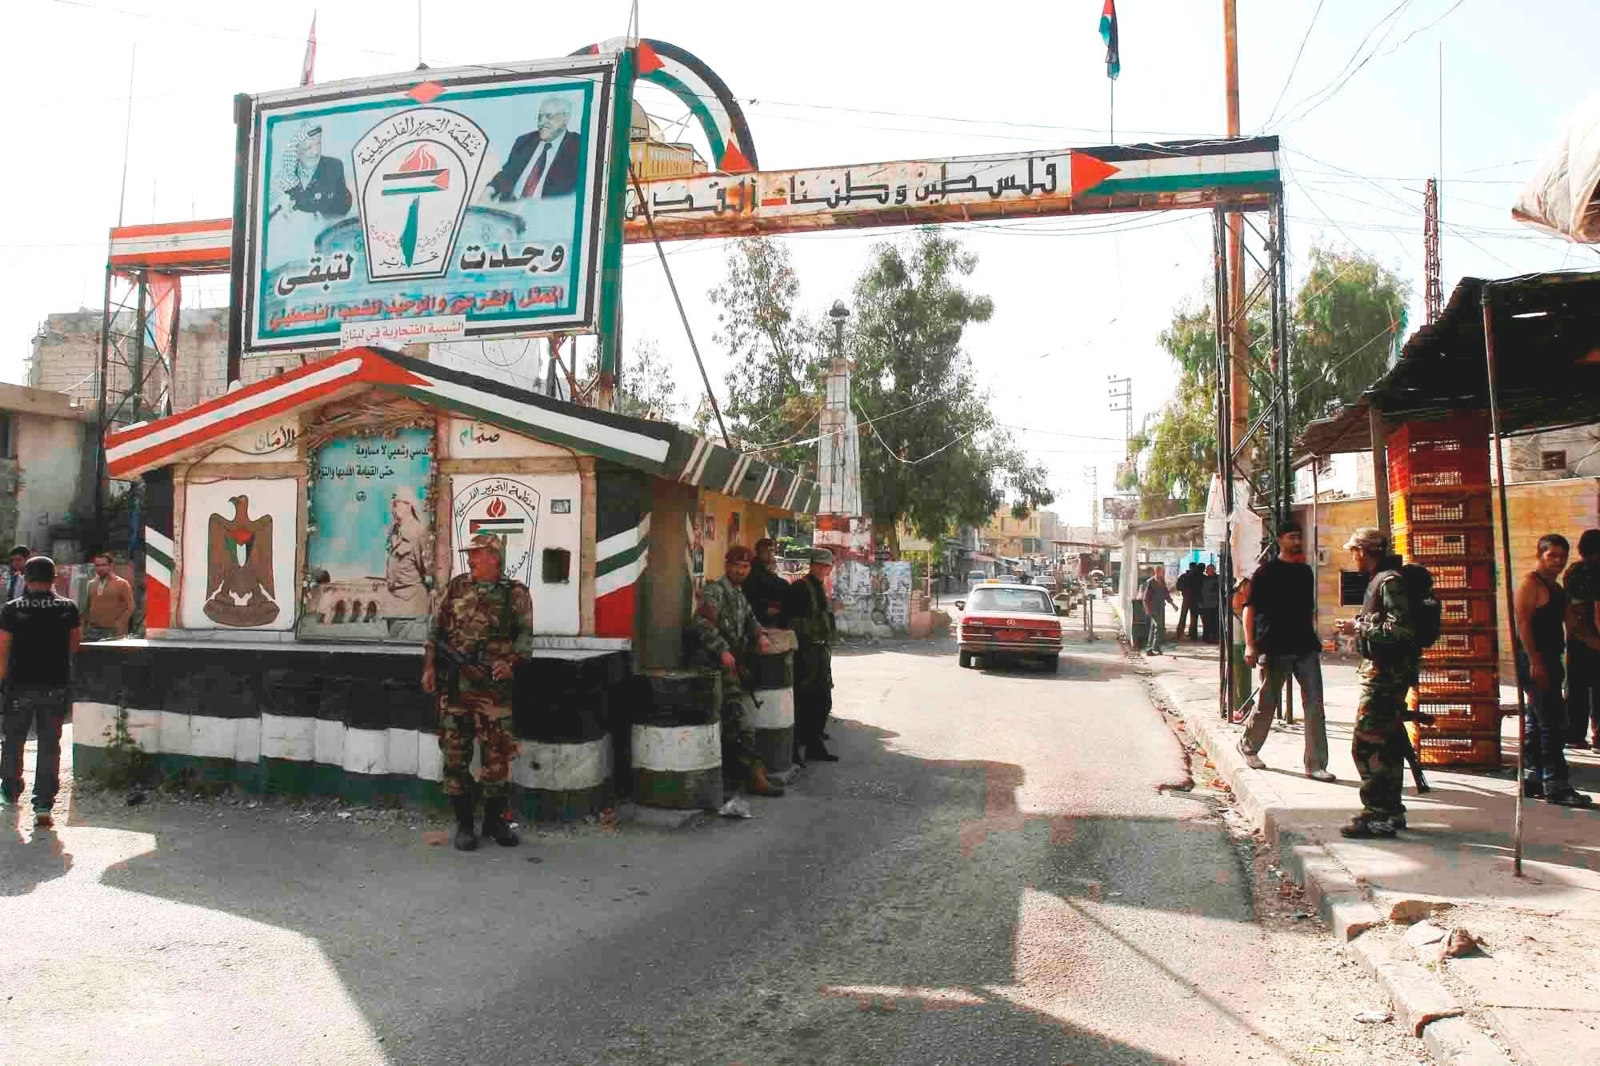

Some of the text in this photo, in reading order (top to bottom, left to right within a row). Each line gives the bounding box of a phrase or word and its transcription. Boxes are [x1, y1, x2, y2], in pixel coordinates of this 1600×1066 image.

[790, 167, 907, 208] وطننا
[915, 157, 1057, 204] فلسطين
[277, 244, 565, 296] وجدت لتبقى
[509, 486, 536, 511] منظمة
